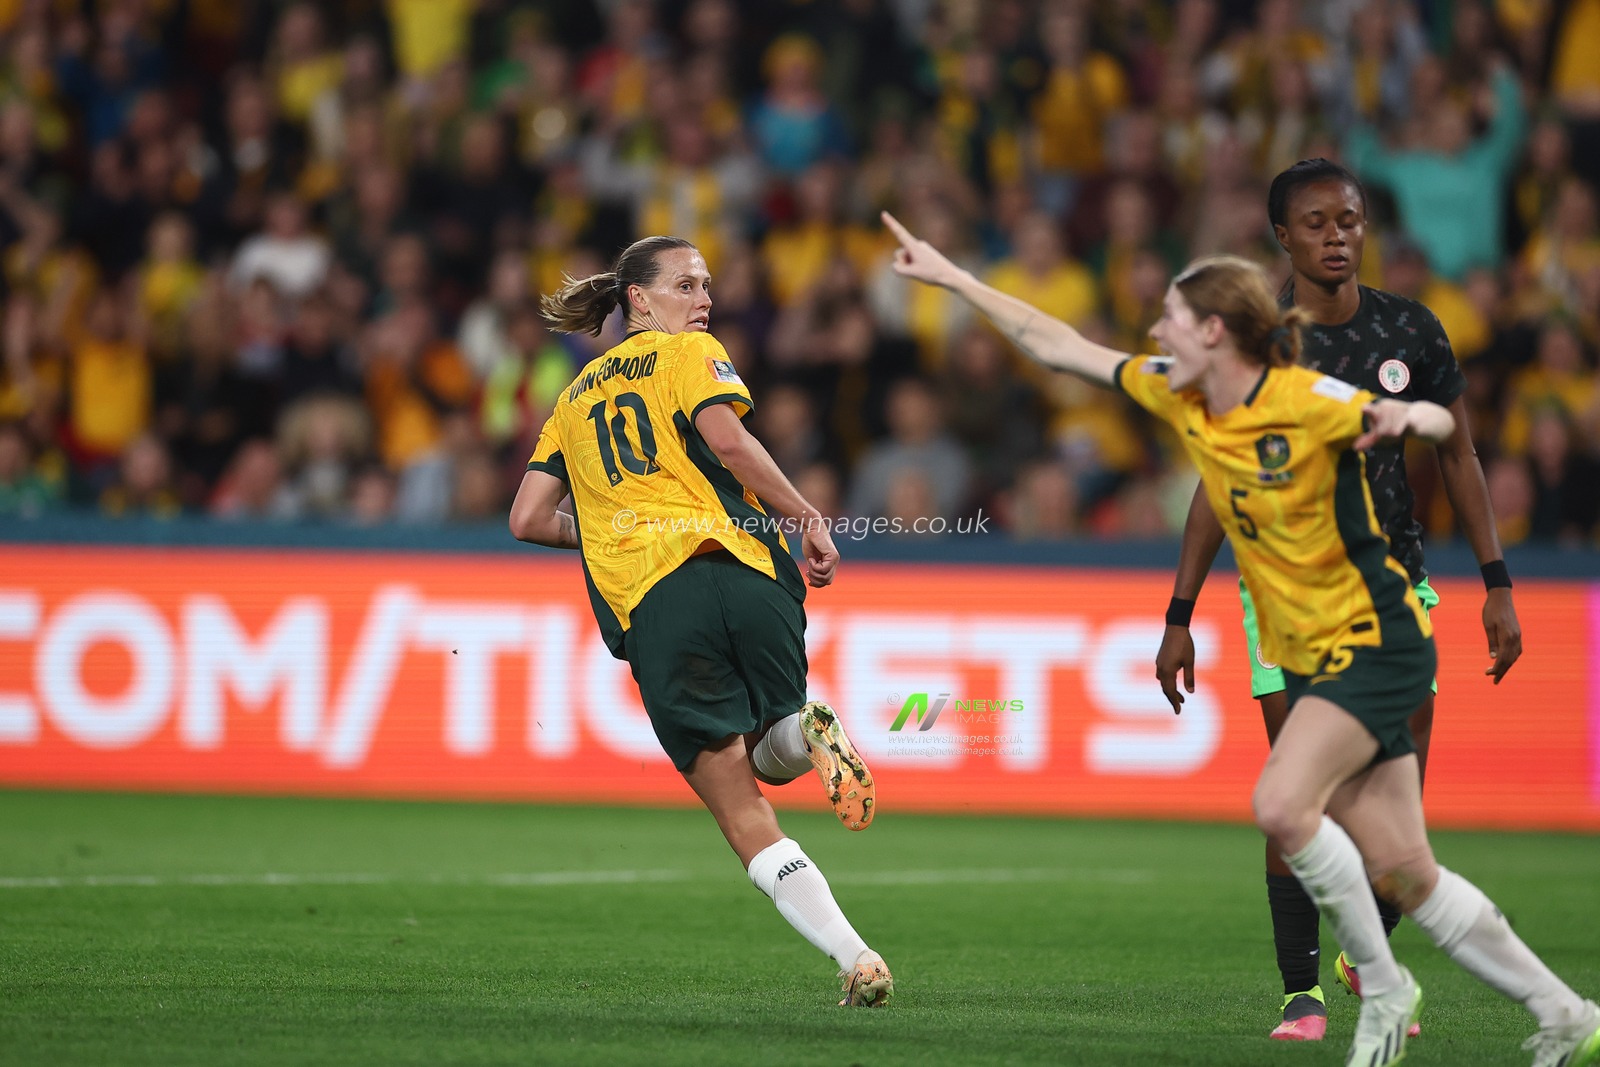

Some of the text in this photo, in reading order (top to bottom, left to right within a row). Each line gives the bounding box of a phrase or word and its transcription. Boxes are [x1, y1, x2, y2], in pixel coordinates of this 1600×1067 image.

[569, 370, 596, 404] VAN
[587, 391, 661, 488] 10
[1230, 488, 1258, 541] 5
[0, 583, 1223, 775] OM/TICETS
[777, 859, 808, 881] AUS
